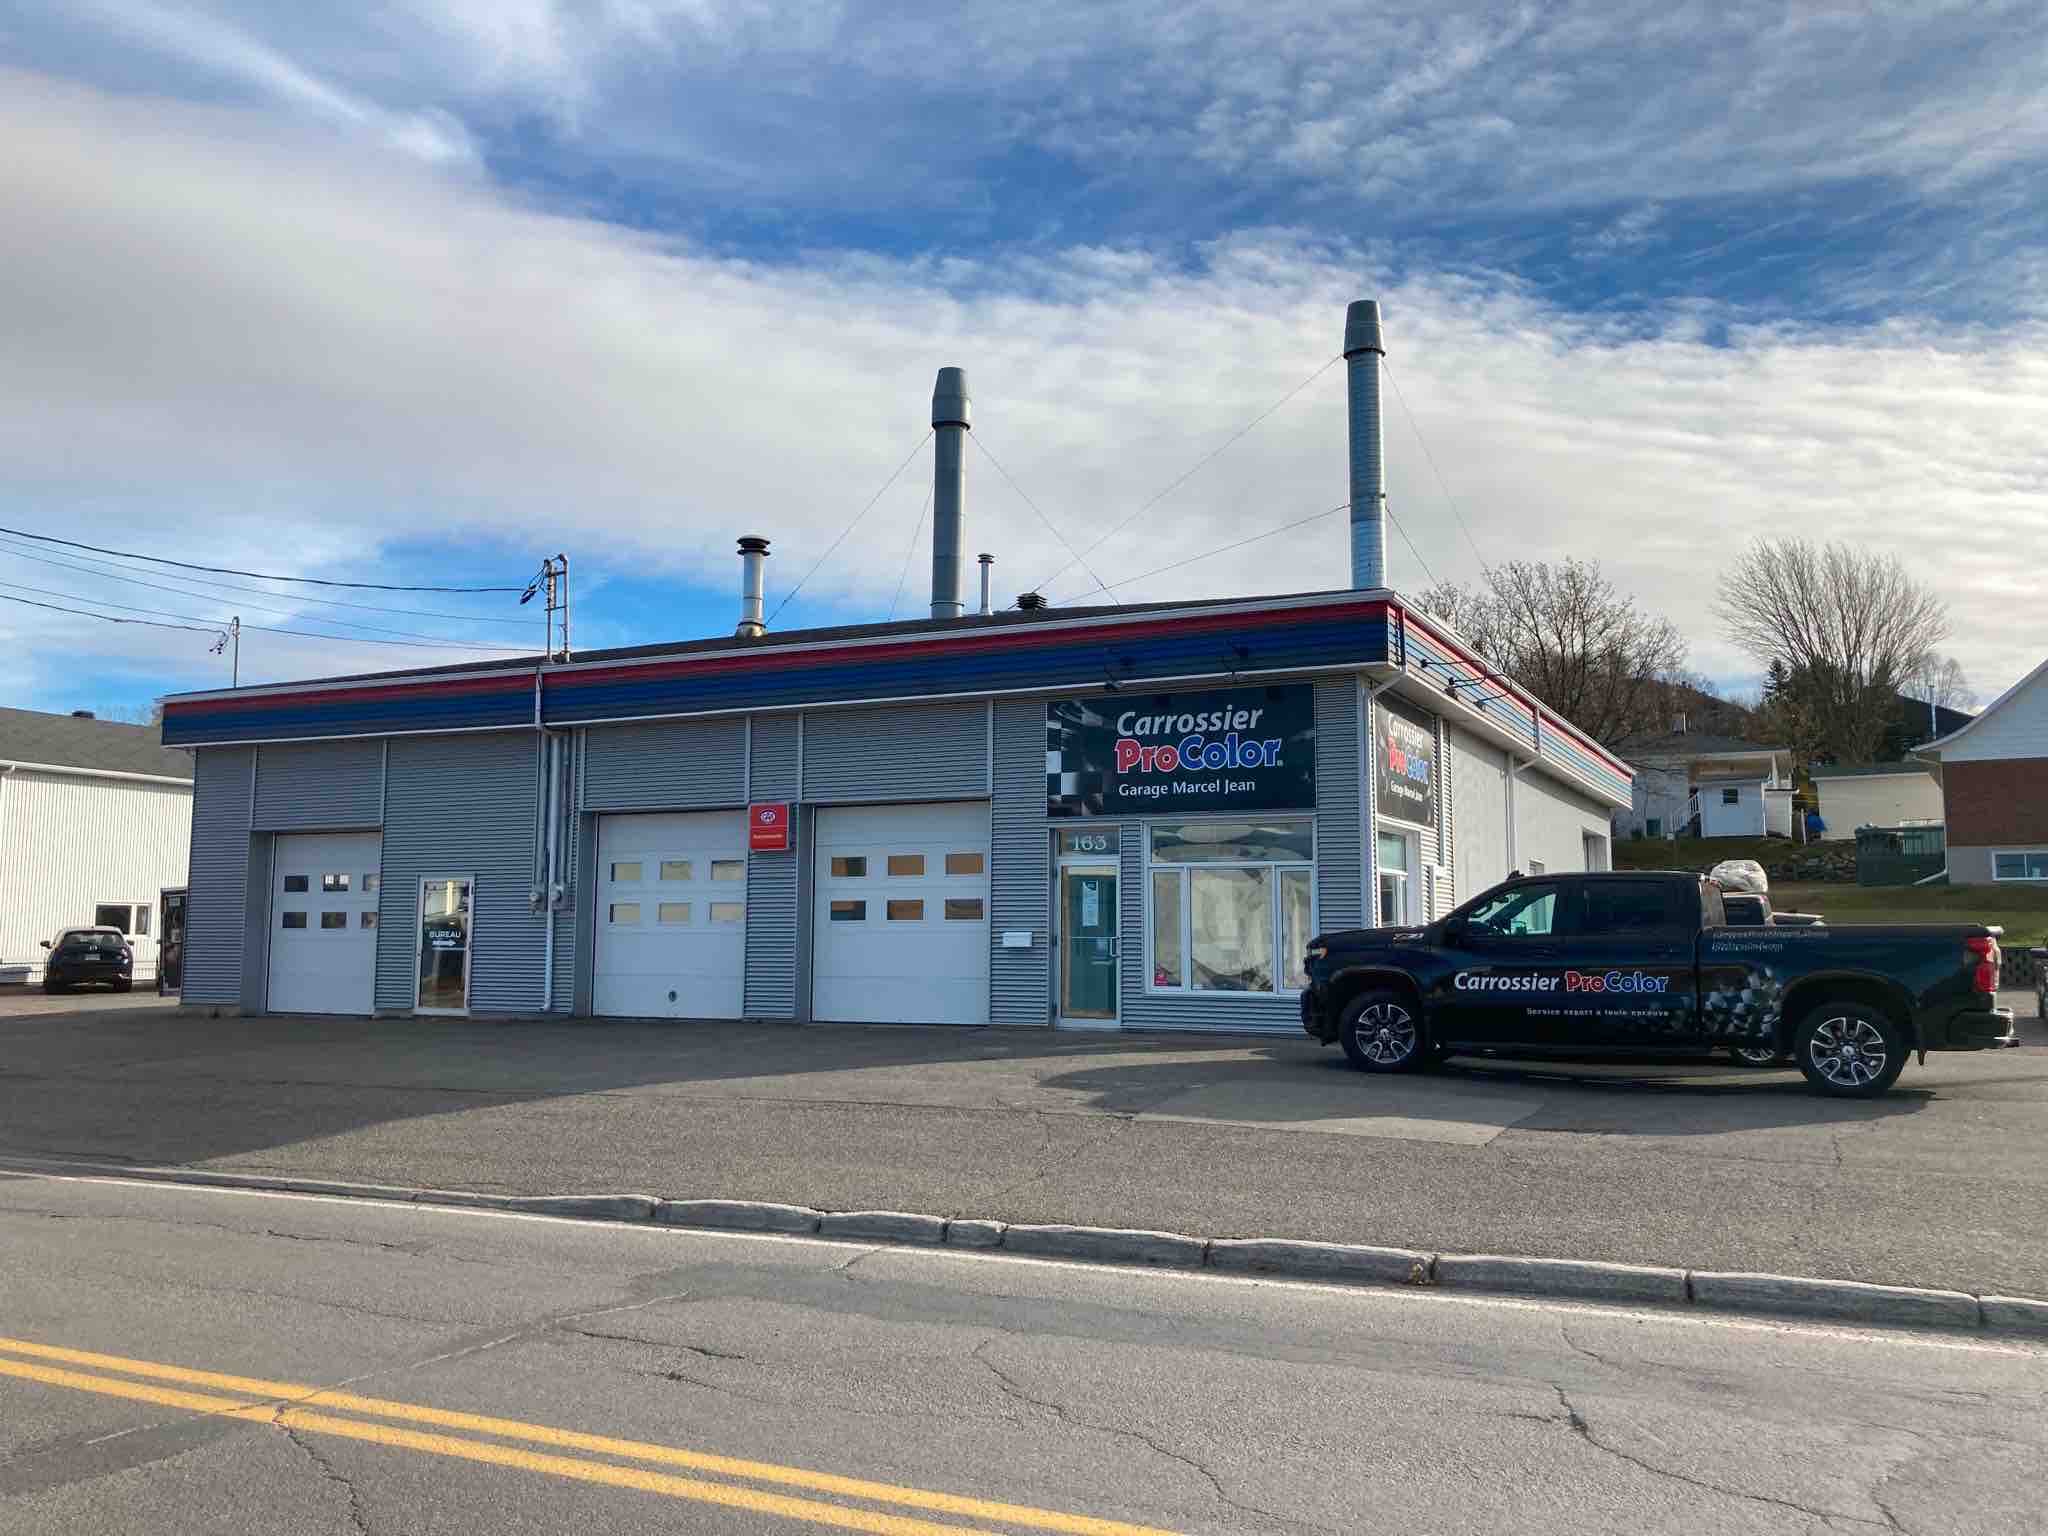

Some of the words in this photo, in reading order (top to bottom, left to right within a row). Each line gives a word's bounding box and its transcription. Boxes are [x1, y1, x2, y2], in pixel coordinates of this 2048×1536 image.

[1116, 704, 1263, 737] Carrossier
[1114, 732, 1281, 773] ProColor
[1118, 783, 1169, 799] Garage
[1173, 779, 1220, 794] Marcel
[1224, 779, 1256, 795] Jean
[429, 930, 461, 938] BUREAU
[1454, 972, 1559, 991] Carrossier
[1564, 970, 1669, 993] ProColor
